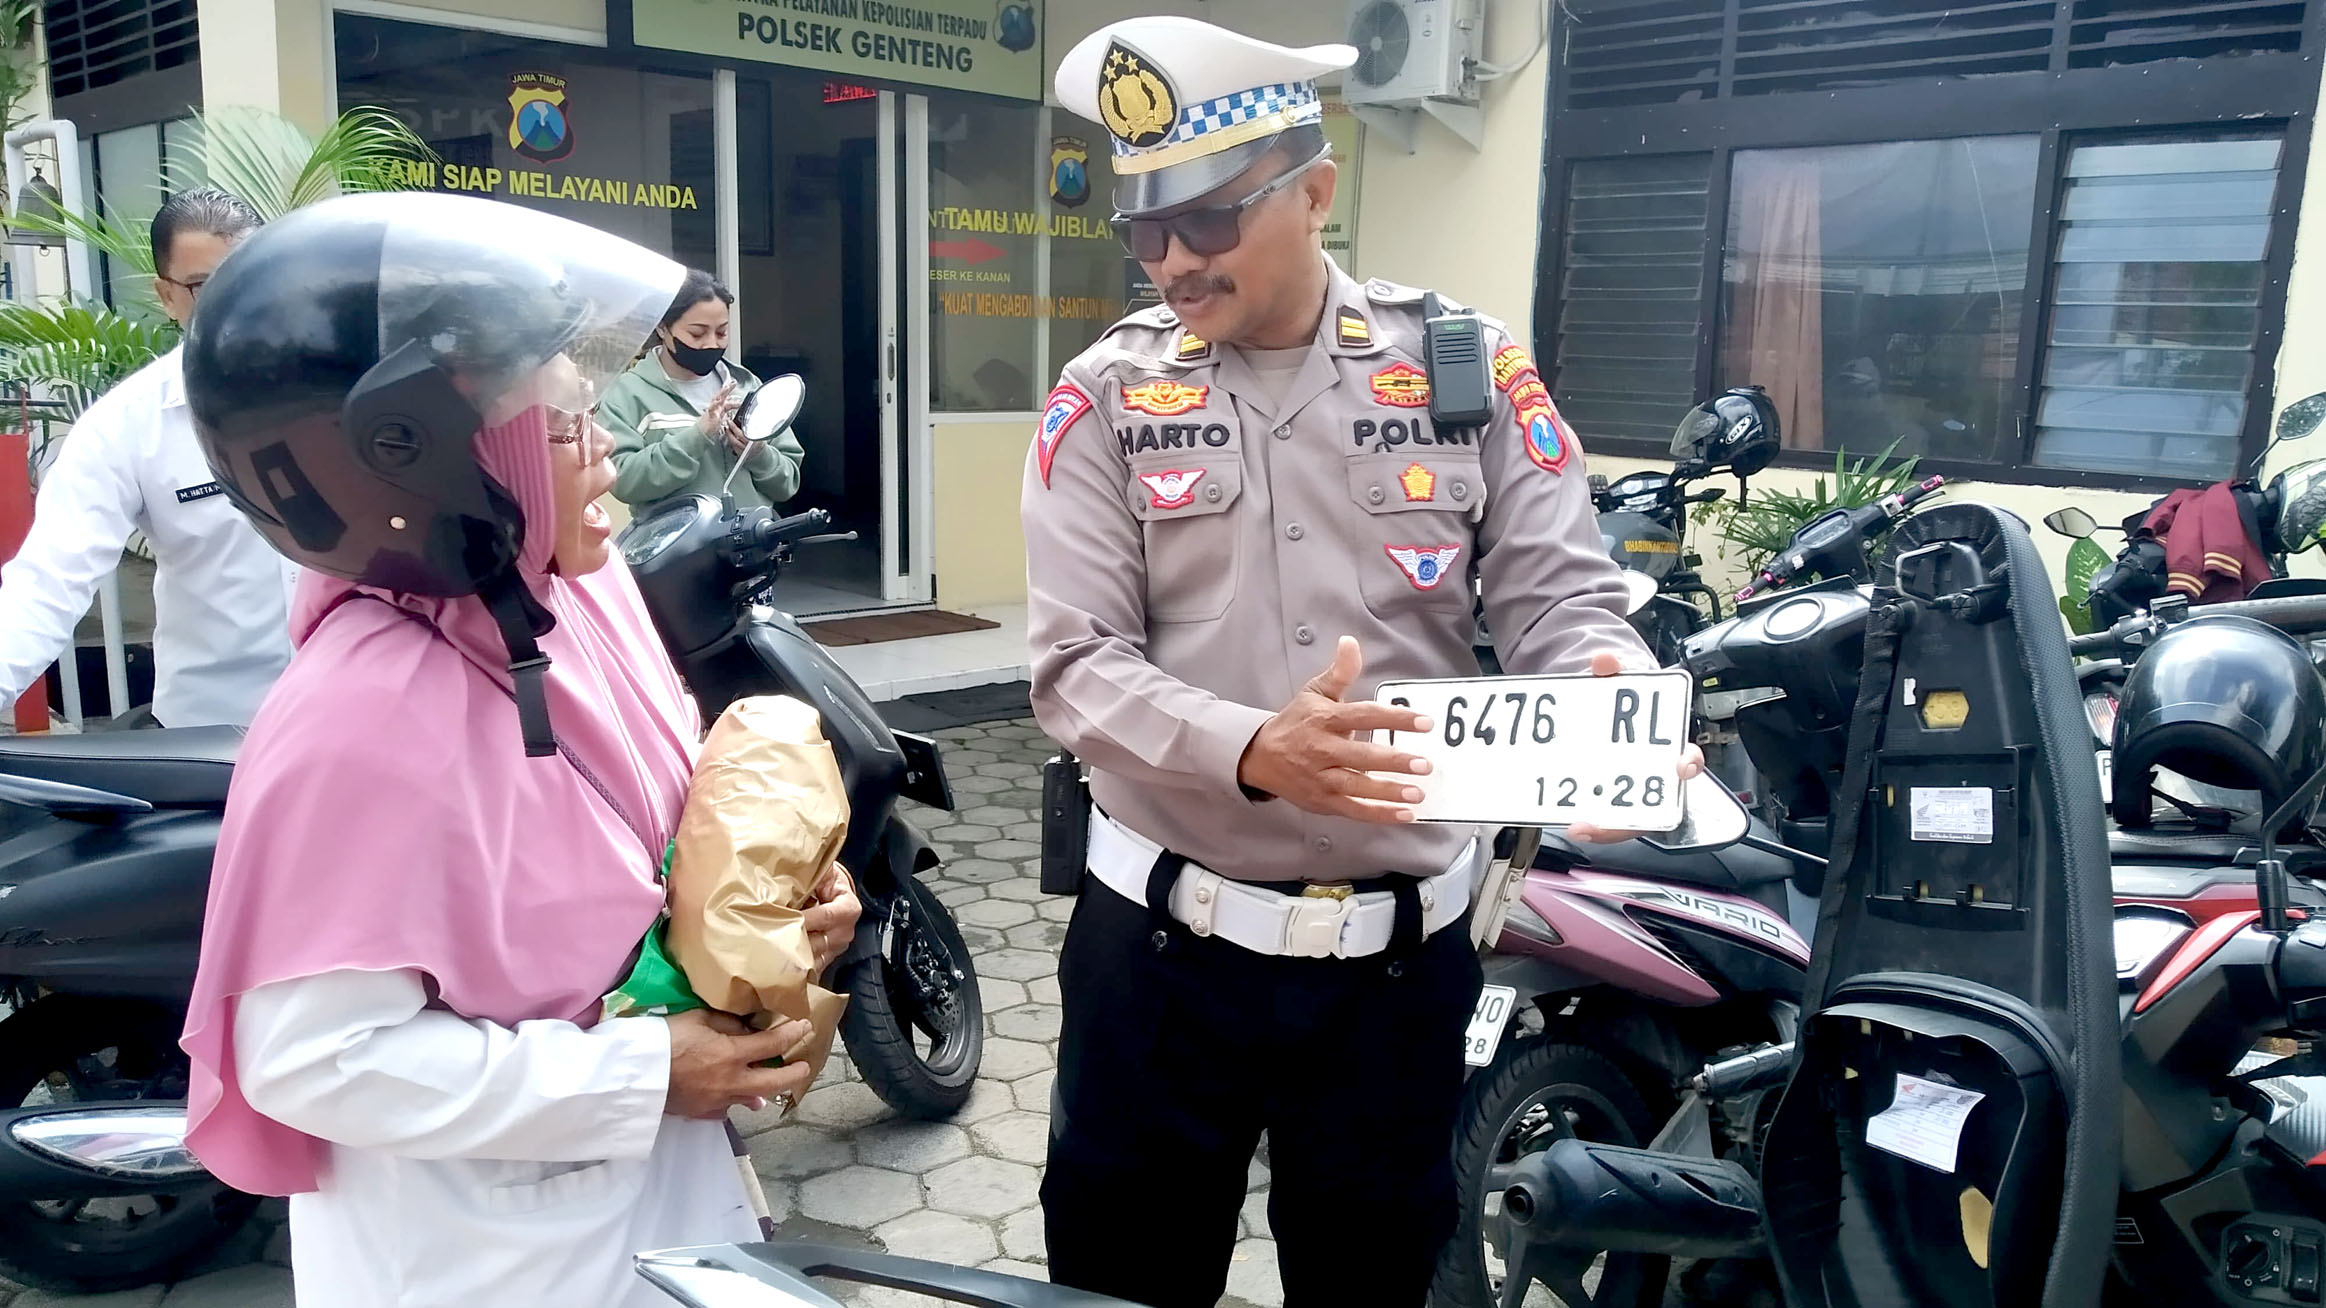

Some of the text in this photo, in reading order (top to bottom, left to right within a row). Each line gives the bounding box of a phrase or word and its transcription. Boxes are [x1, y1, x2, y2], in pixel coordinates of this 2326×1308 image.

[861, 1, 933, 32] KEPOLISIAN
[937, 13, 988, 40] TERPADU
[738, 11, 973, 73] POLSEK GENTENG
[512, 73, 566, 89] JAWA TIMUR
[442, 163, 502, 192] SIAP
[508, 171, 629, 206] MELAYANI
[633, 183, 698, 210] ANDA
[943, 207, 1008, 234] TAMU
[960, 271, 974, 282] KE
[976, 271, 1011, 284] KANAN
[976, 293, 1033, 318] MENGABDI
[1058, 295, 1099, 319] SANTUN
[1117, 422, 1231, 458] HARTO
[190, 486, 214, 497] HATTA
[1444, 692, 1557, 748] 6476
[1611, 687, 1672, 746] RL
[1659, 887, 1781, 939] VARIO
